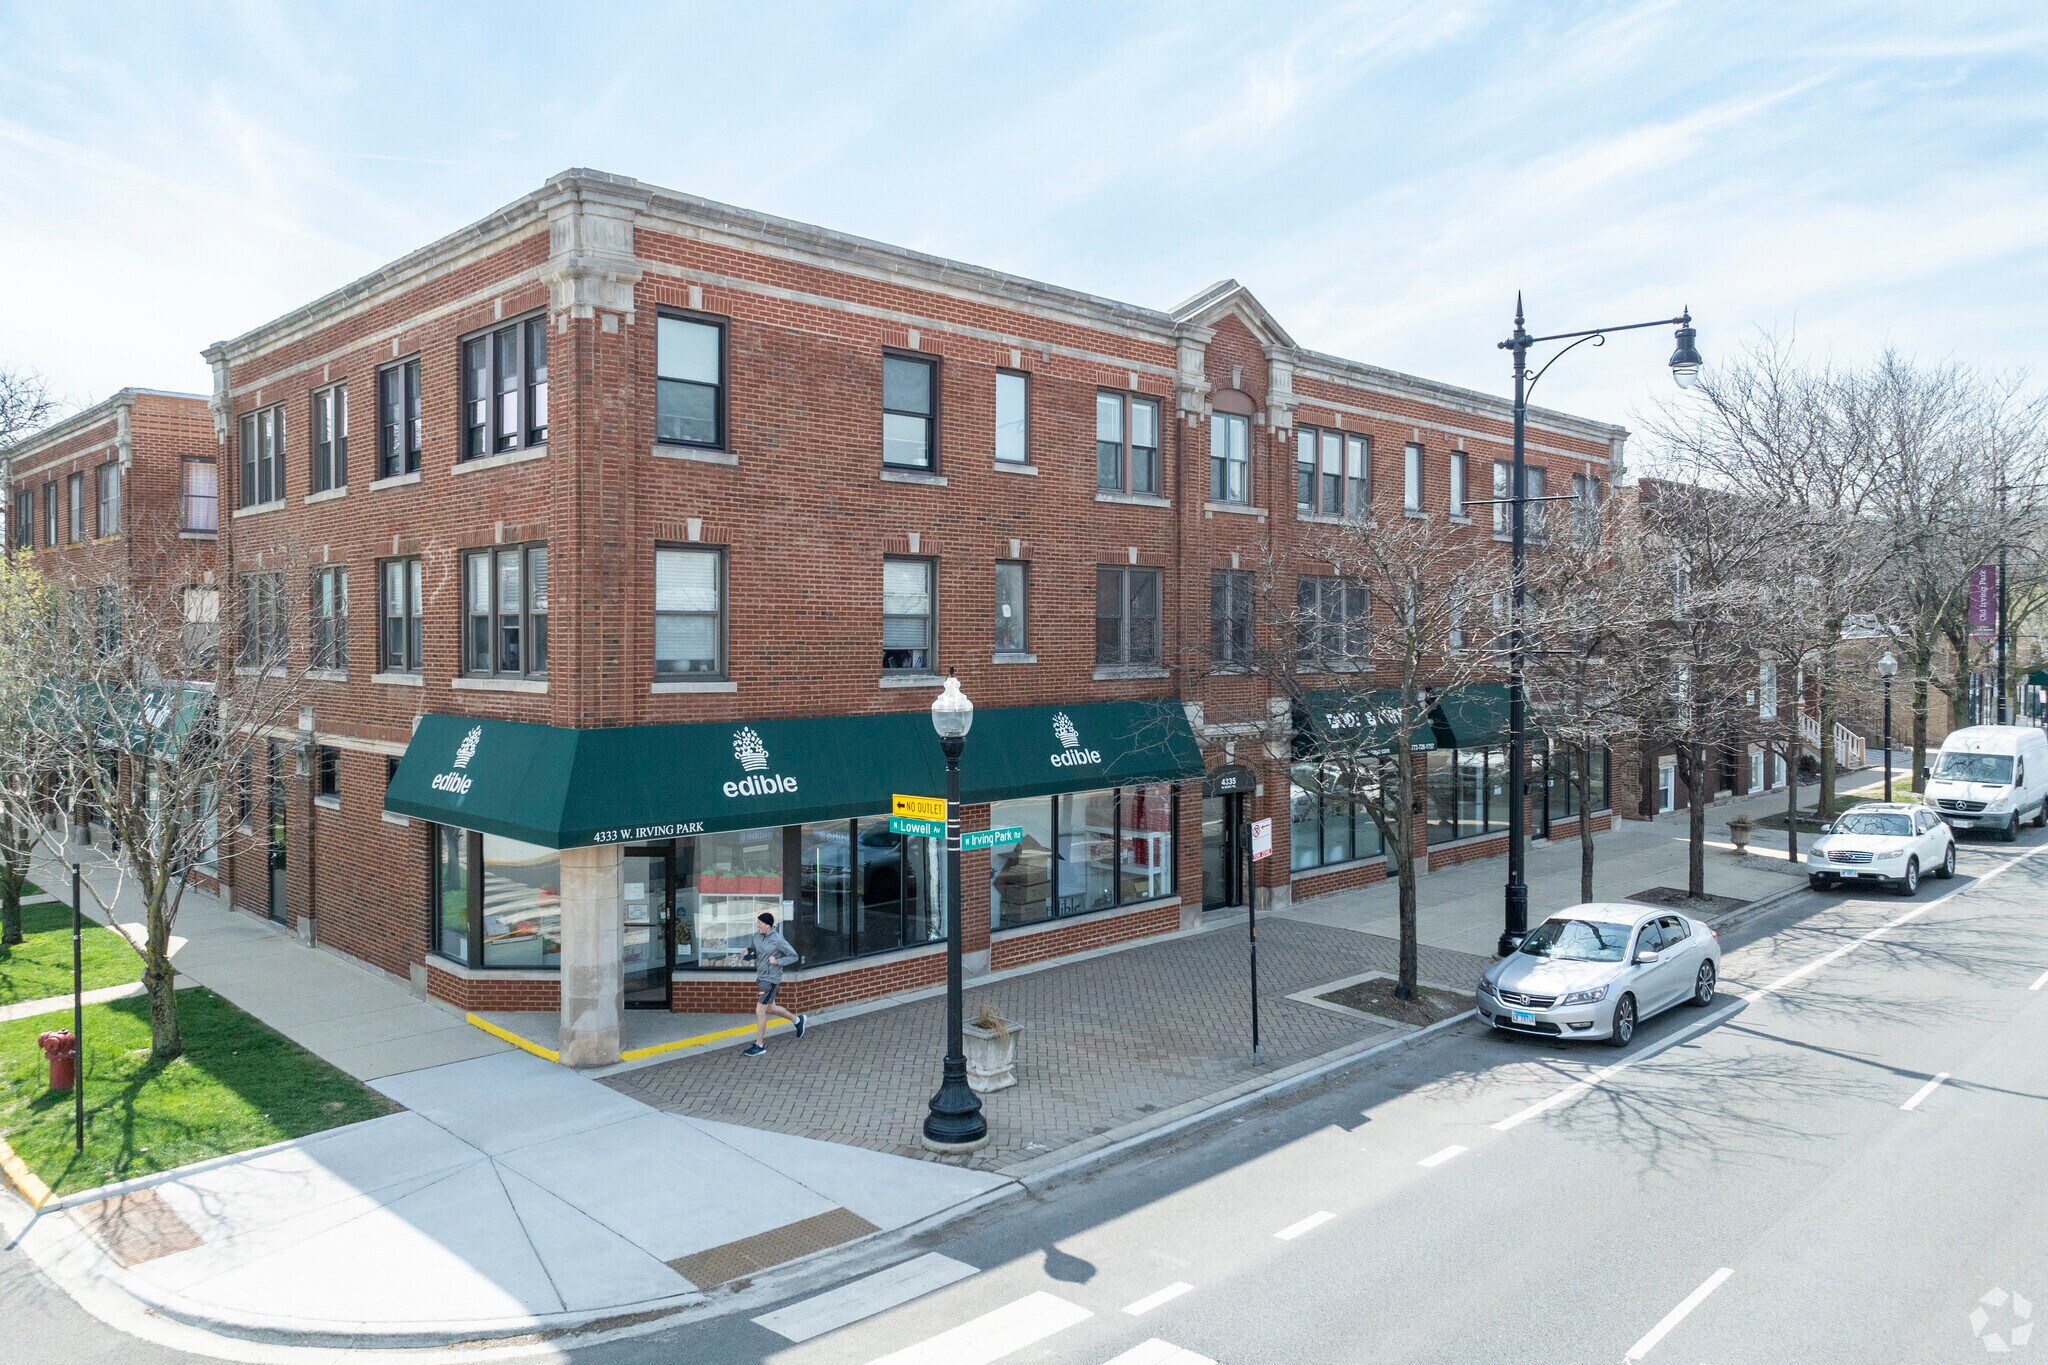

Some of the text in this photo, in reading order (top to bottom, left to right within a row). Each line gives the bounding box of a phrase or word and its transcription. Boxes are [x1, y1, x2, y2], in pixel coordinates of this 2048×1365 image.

[1979, 570, 1987, 585] Park
[1979, 609, 1987, 621] Old
[1050, 748, 1101, 767] edible
[431, 772, 472, 794] edible
[723, 774, 798, 798] edible
[1221, 777, 1236, 786] 4335
[906, 801, 942, 815] NO OUTLET
[593, 821, 704, 842] 4333 W. IRVING PARK
[893, 820, 941, 834] N Lowell Av
[971, 833, 994, 847] Irving
[994, 830, 1012, 843] Park
[1013, 831, 1021, 839] Rd
